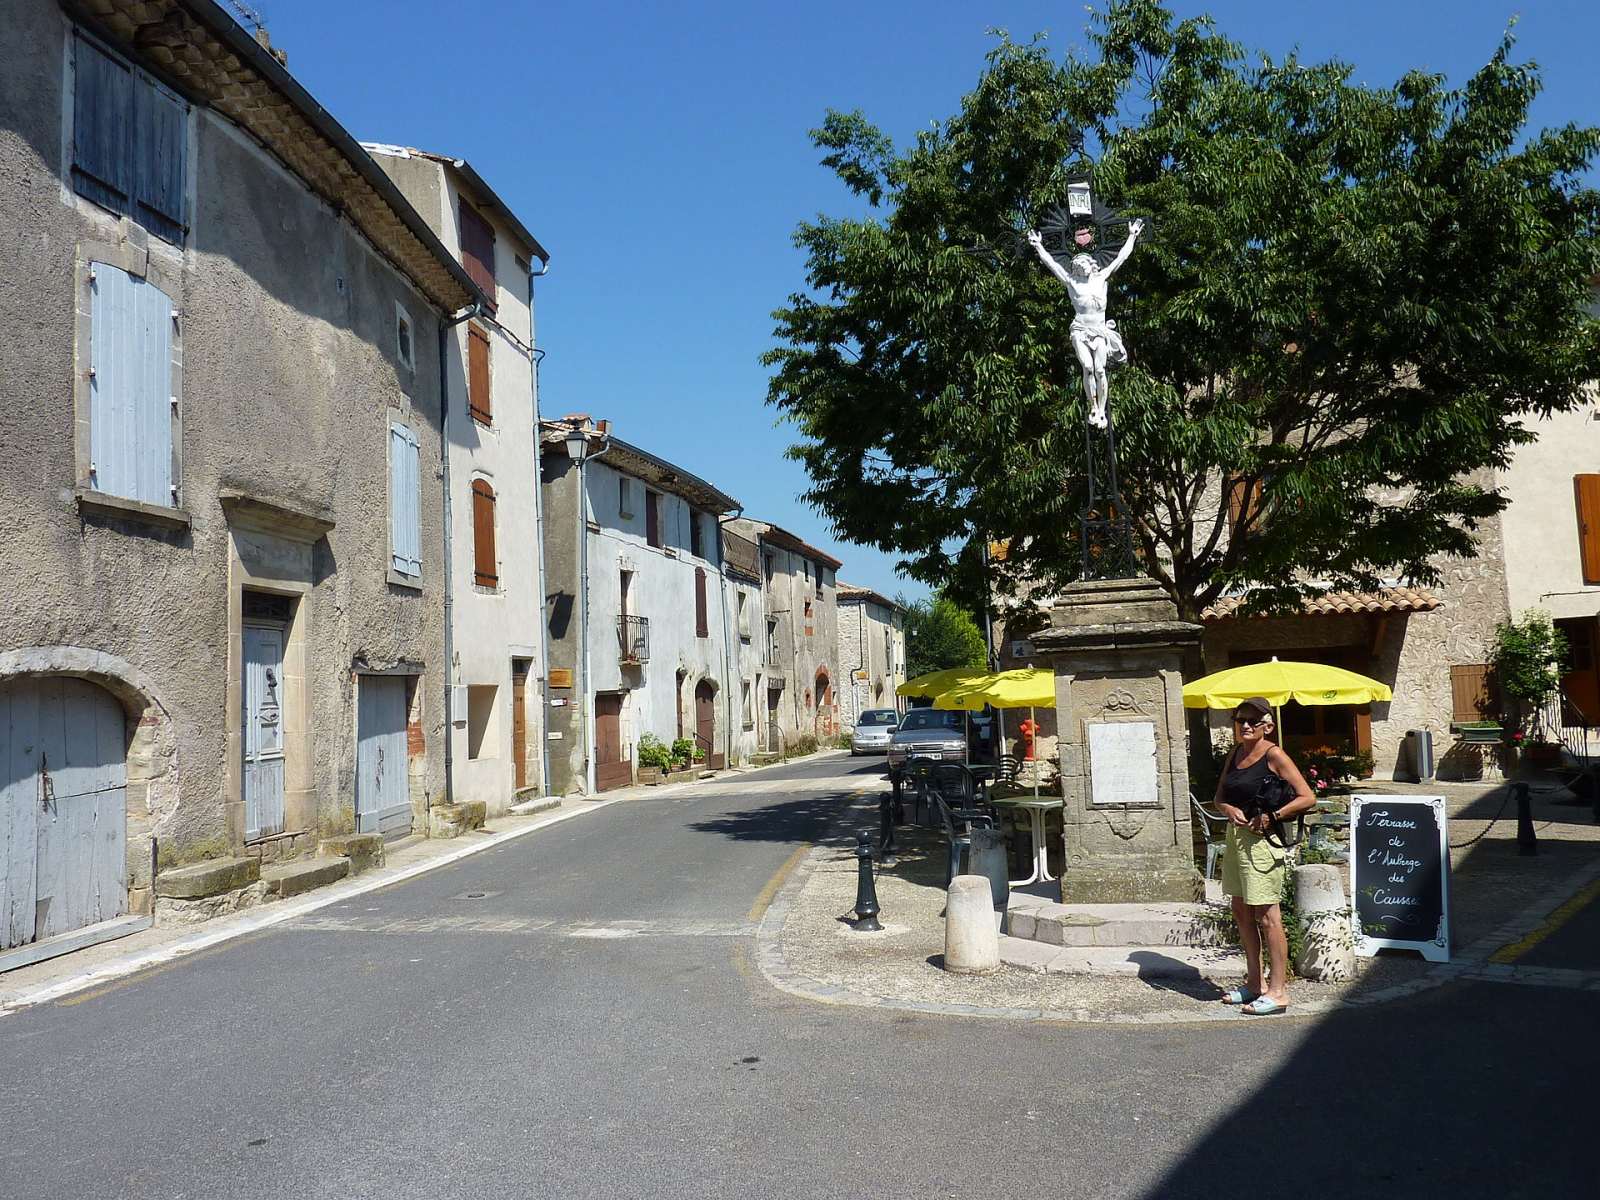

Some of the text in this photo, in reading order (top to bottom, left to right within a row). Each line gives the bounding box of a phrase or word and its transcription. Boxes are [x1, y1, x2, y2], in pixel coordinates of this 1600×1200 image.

[1069, 193, 1089, 208] INRI
[1366, 810, 1417, 829] Terrasse
[1388, 836, 1405, 847] de
[1367, 848, 1422, 873] l'Auberge
